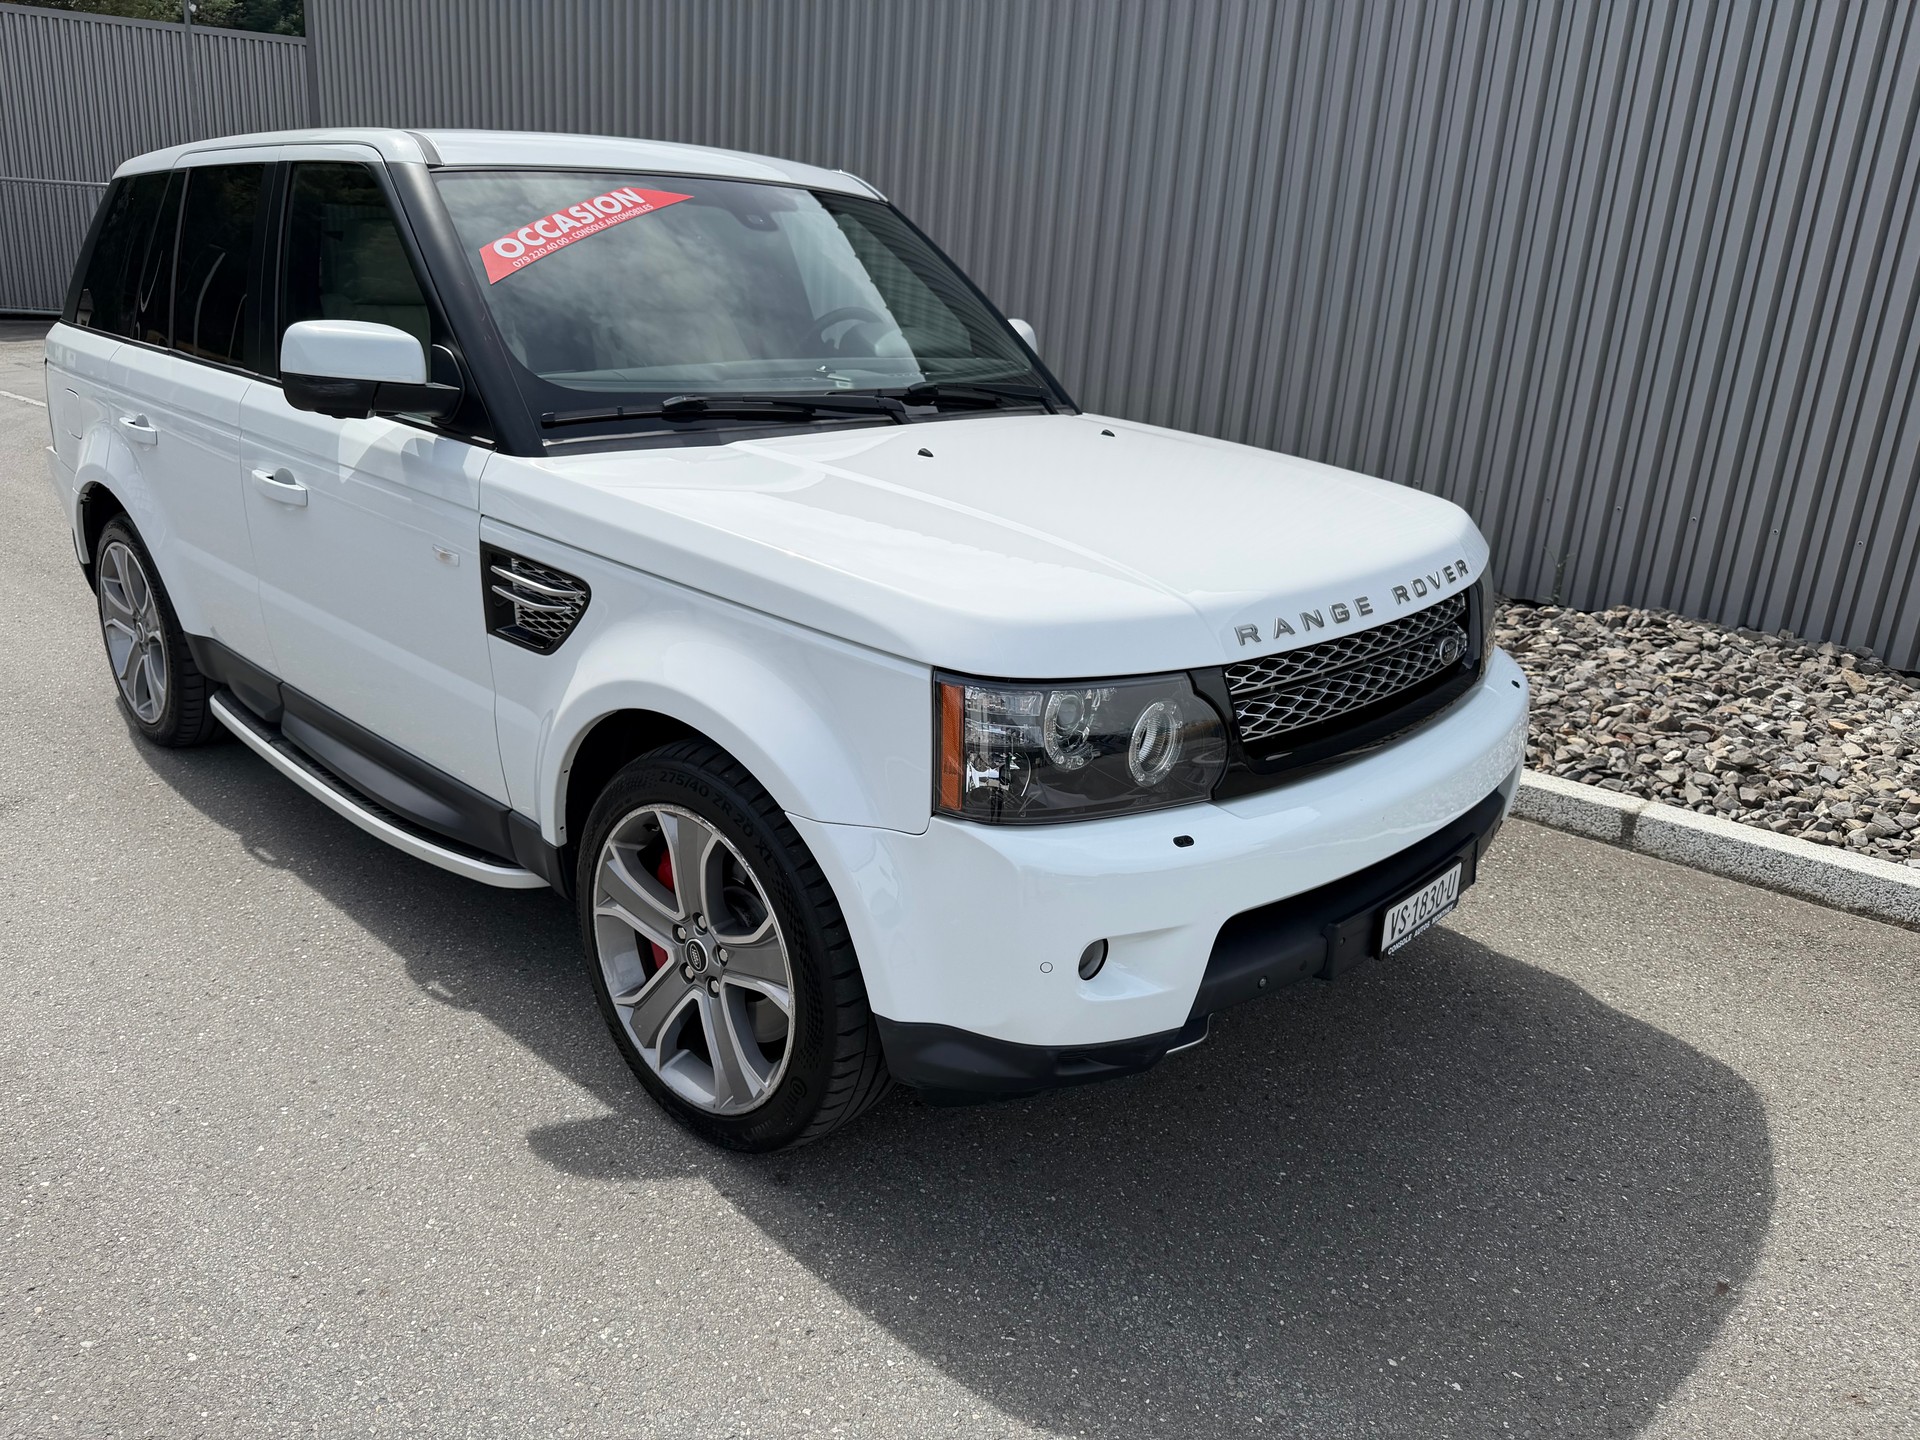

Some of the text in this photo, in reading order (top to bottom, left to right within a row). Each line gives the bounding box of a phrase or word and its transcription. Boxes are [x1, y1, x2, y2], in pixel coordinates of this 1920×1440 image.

[493, 187, 646, 259] OCCASION
[512, 255, 531, 268] 079
[529, 248, 547, 260] 220
[546, 242, 559, 253] 40
[557, 236, 570, 248] 00
[571, 221, 608, 241] CONSOLE
[605, 203, 655, 227] AUTOMOBILES
[1234, 559, 1470, 646] RANGE ROVER
[659, 771, 710, 798] 275/40
[711, 792, 734, 817] ZR
[733, 812, 755, 838] 20
